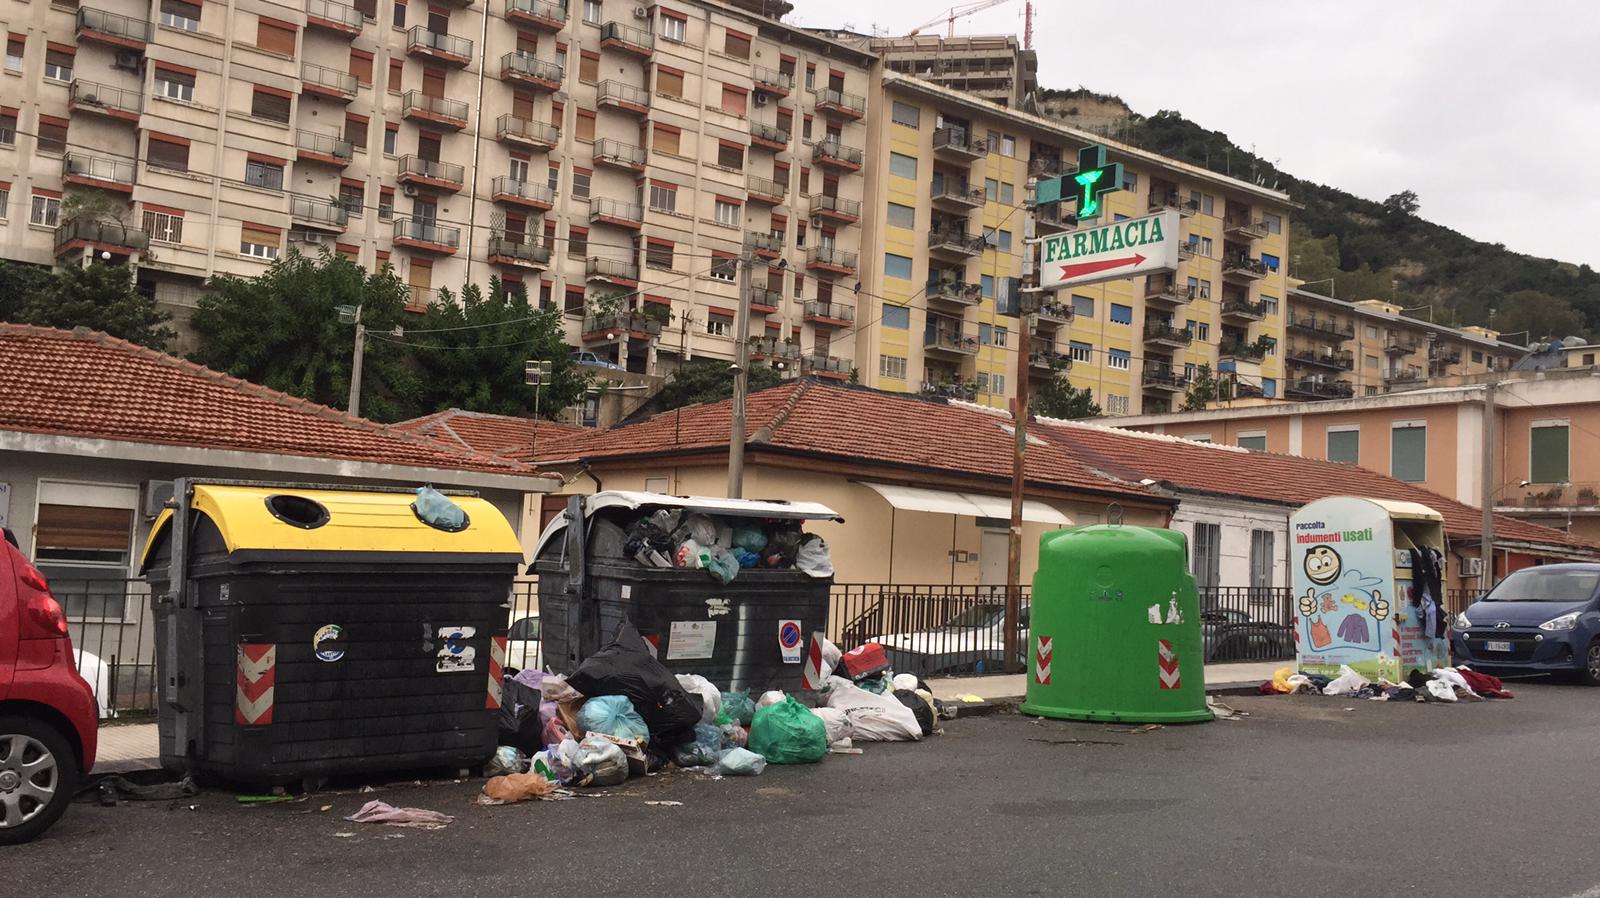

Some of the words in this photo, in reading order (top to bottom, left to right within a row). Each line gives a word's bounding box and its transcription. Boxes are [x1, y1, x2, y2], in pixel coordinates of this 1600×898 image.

[1045, 217, 1164, 263] FARMACIA
[1296, 521, 1325, 530] raccolta
[1296, 531, 1341, 544] indumenti
[1343, 528, 1373, 541] usati
